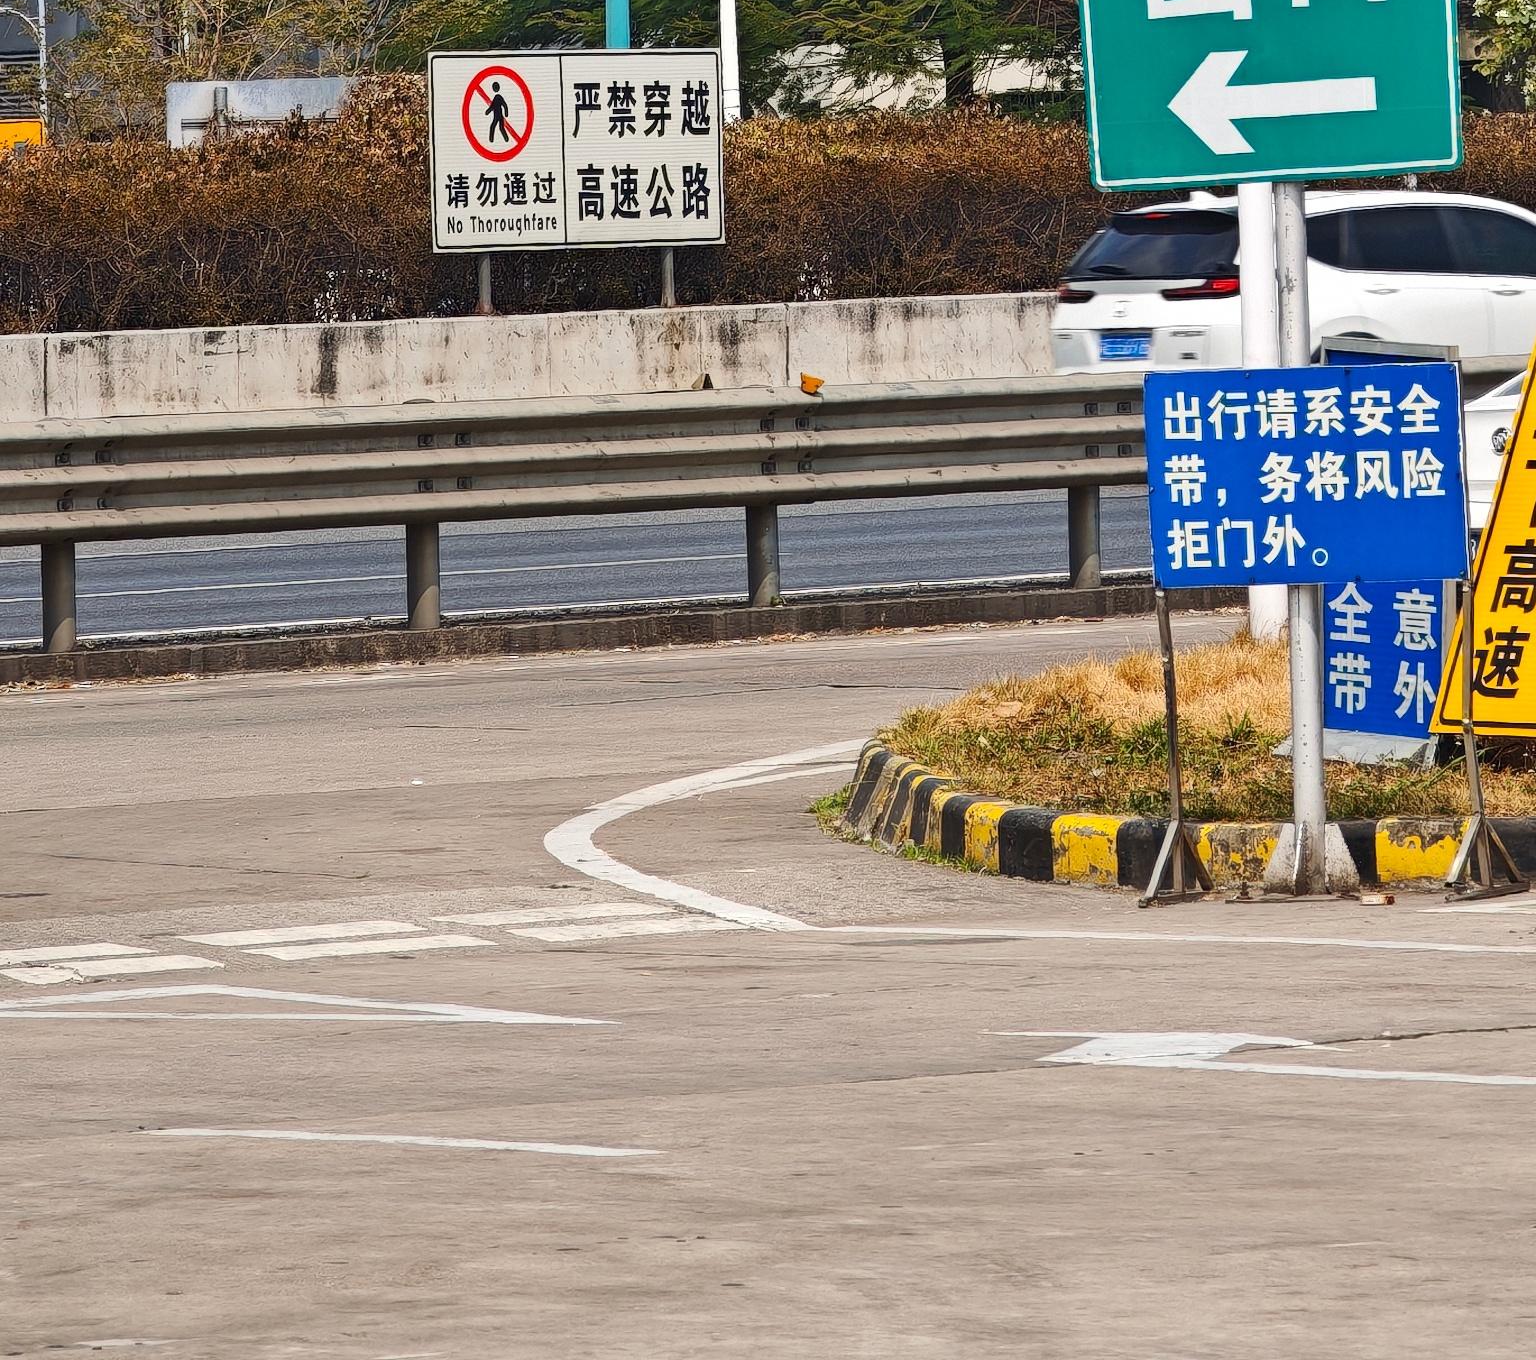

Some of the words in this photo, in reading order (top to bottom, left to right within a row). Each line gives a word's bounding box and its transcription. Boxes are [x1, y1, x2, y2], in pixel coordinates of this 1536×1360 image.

[572, 80, 711, 139] 严禁穿越
[445, 171, 557, 209] 请勿通过
[576, 162, 712, 222] 高速公路
[447, 216, 463, 235] No
[1163, 382, 1441, 442] 出行请系安全
